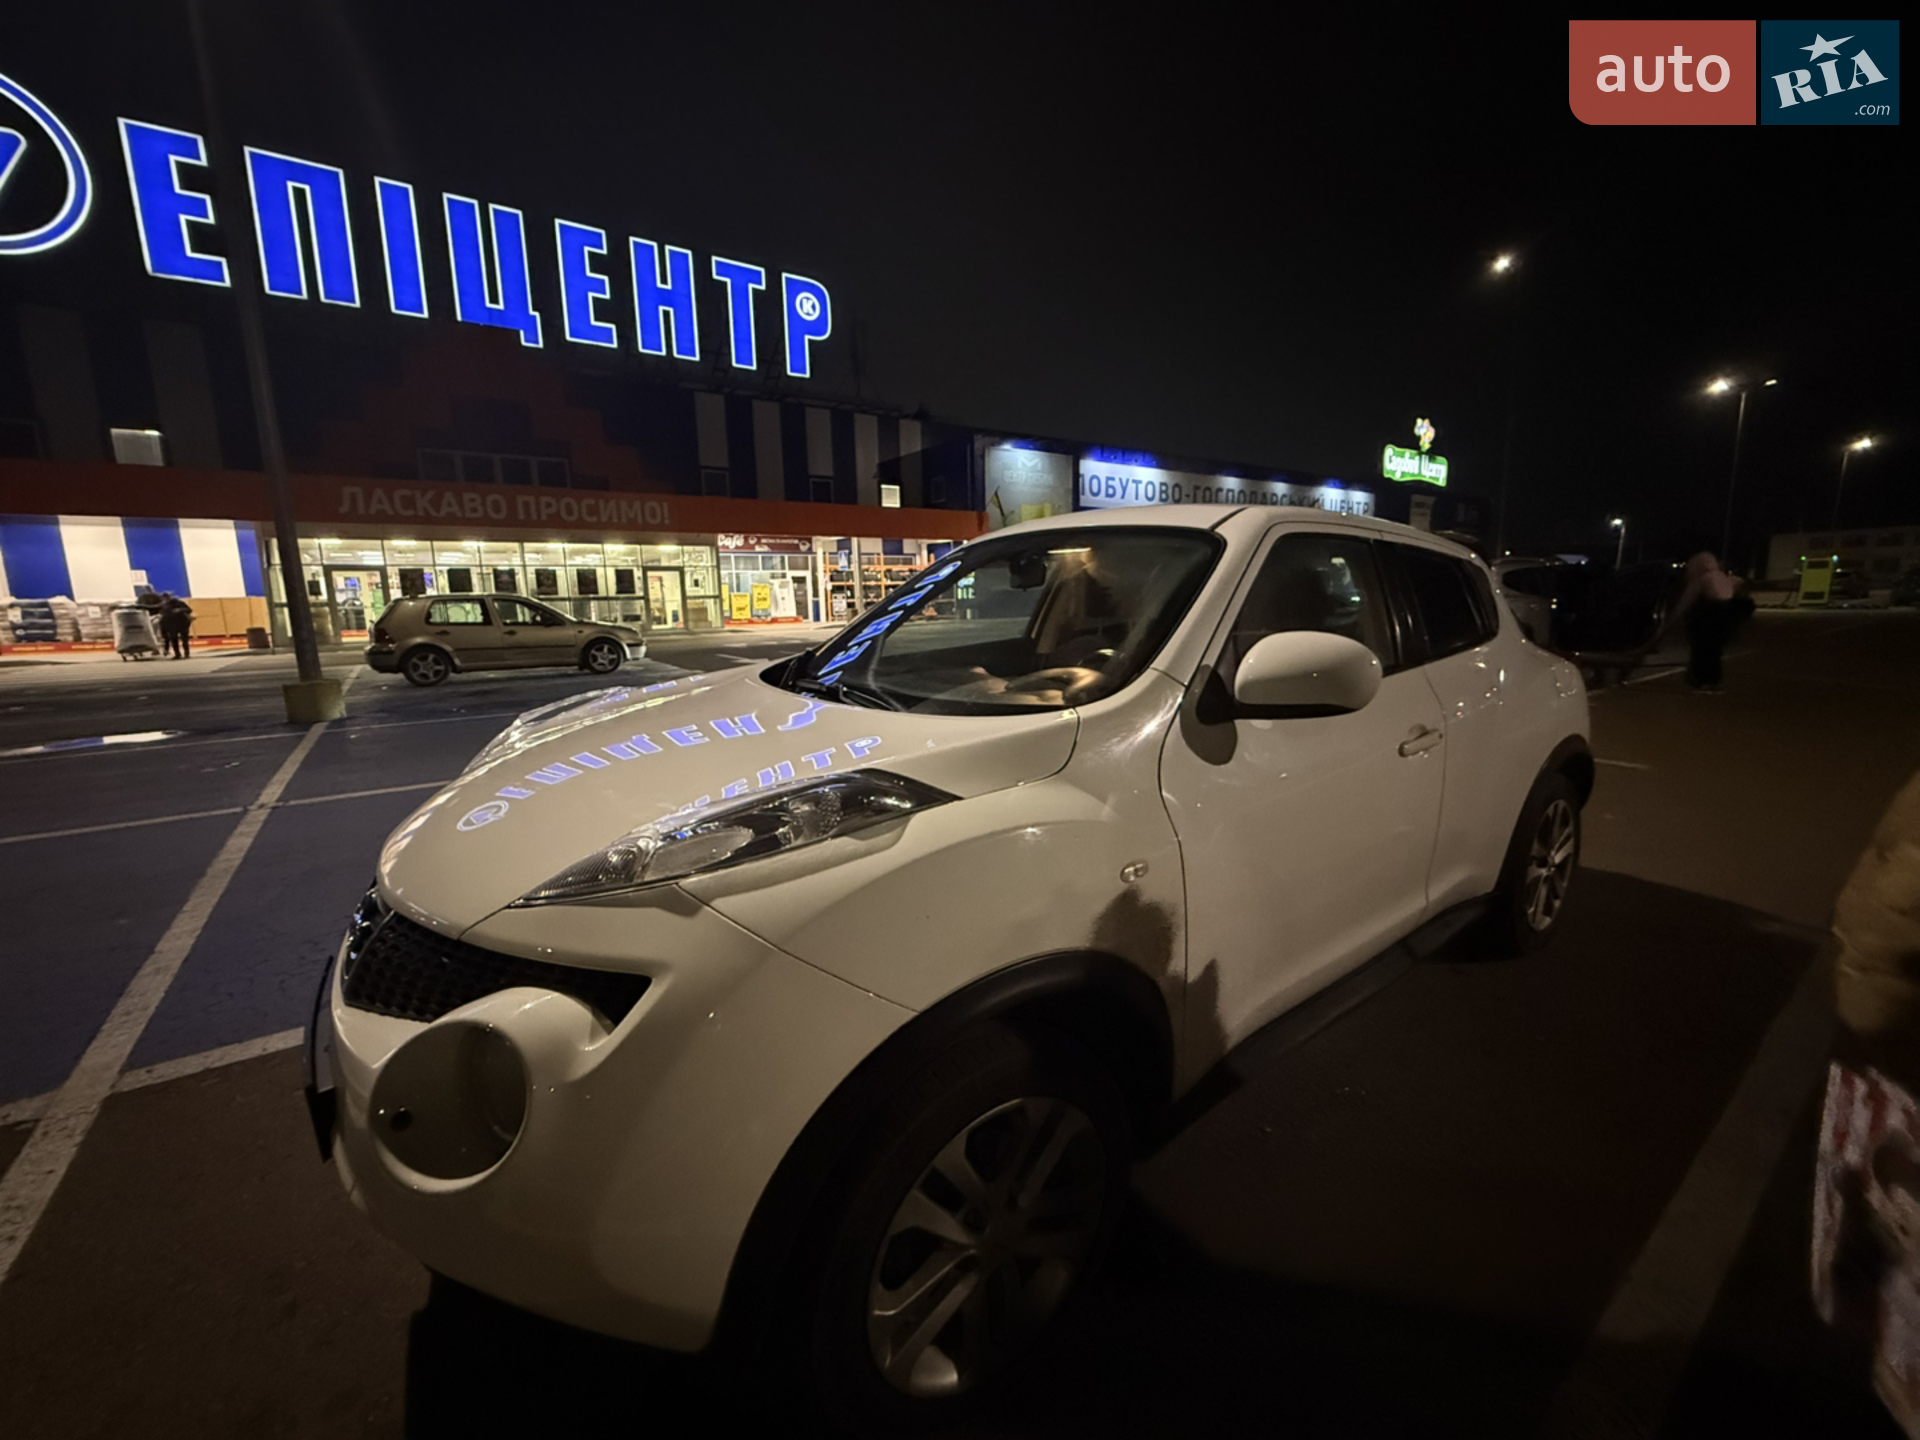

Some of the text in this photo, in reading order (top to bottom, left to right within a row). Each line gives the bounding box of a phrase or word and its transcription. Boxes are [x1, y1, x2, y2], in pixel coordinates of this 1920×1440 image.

[117, 116, 832, 378] ЕПІЦЕНТР
[338, 485, 671, 526] ЛАСКАВО ПРОСИМО!
